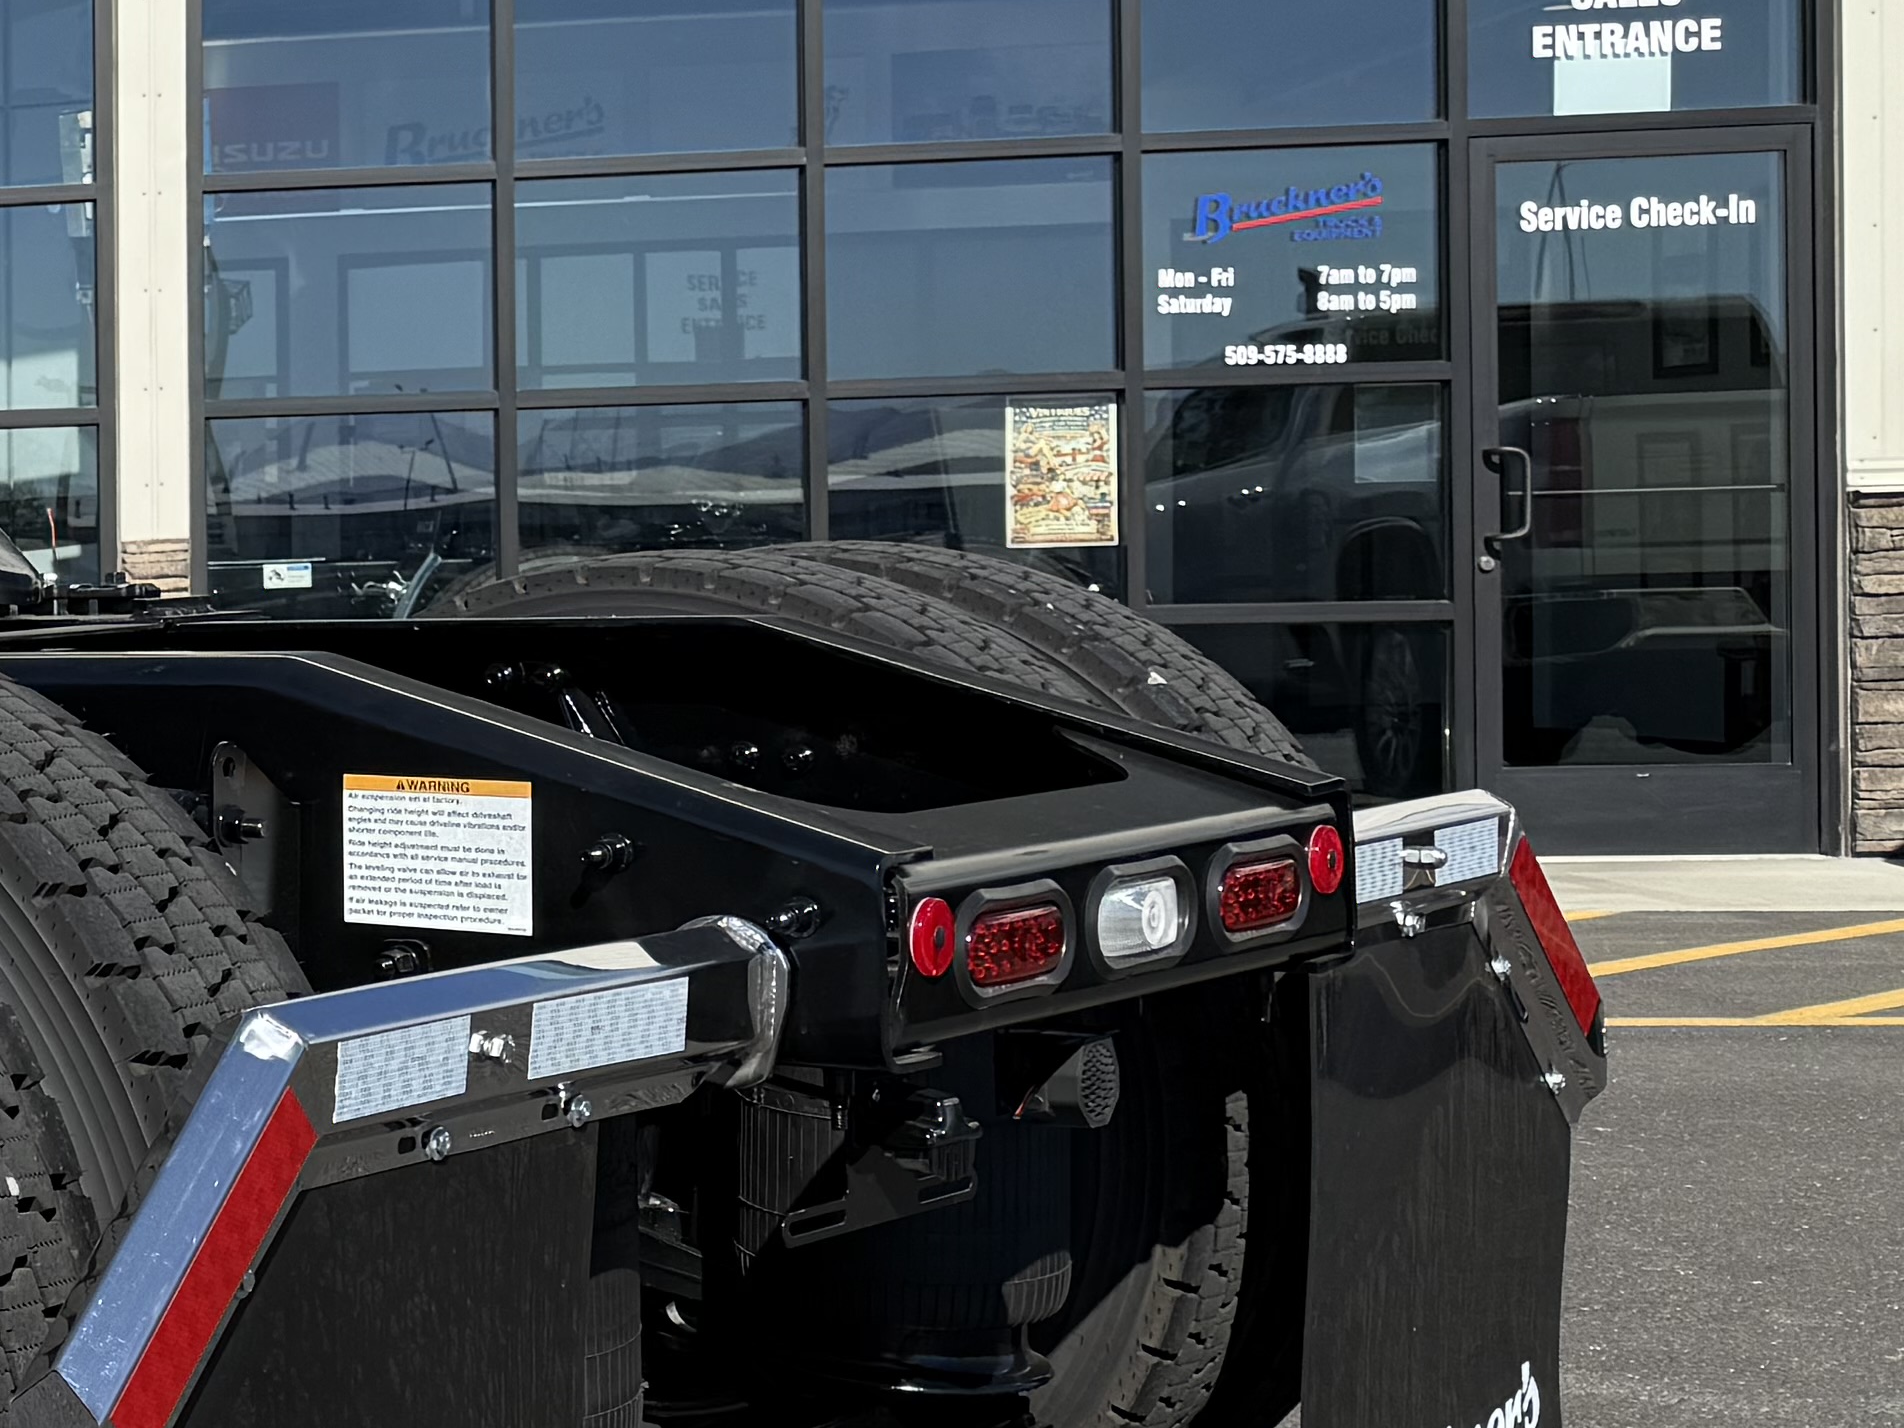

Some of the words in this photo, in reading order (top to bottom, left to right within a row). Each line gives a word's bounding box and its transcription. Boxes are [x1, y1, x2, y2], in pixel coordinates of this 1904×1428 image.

[1532, 18, 1723, 61] ENTRANCE
[383, 97, 607, 168] Brucner's
[1193, 172, 1384, 245] Bruckner's
[1519, 199, 1623, 233] Service
[1629, 194, 1757, 231] Check-In
[1157, 268, 1195, 288] Mon
[1210, 267, 1235, 287] Fri
[1316, 265, 1355, 285] 7am
[1357, 265, 1376, 285] to
[1379, 264, 1417, 287] 7pm
[1157, 294, 1233, 316] Saturday
[1316, 291, 1355, 311] 8am
[1357, 291, 1376, 311] to
[1379, 290, 1417, 314] 5pm
[1223, 343, 1348, 366] 509-575-8888
[407, 780, 470, 793] WARNING
[348, 805, 385, 815] Changing
[405, 808, 429, 816] height
